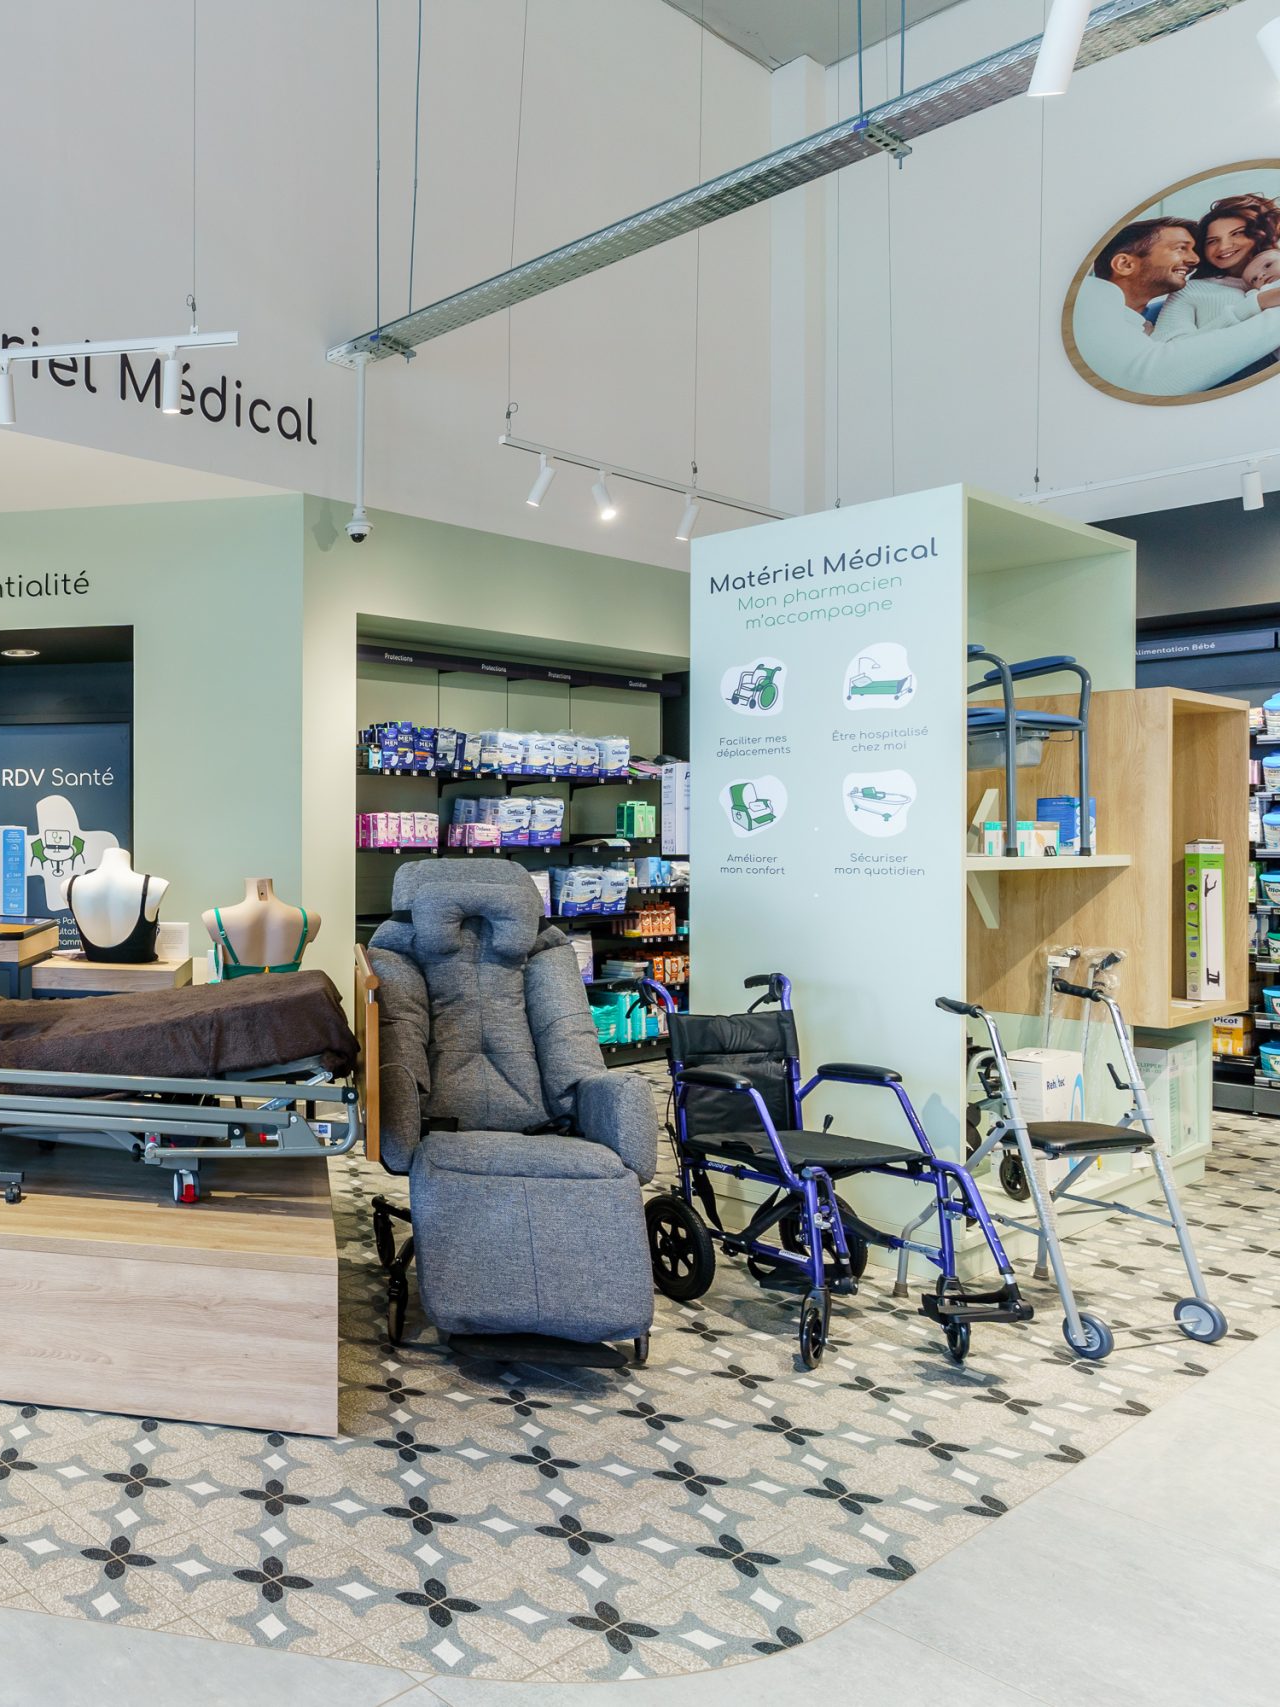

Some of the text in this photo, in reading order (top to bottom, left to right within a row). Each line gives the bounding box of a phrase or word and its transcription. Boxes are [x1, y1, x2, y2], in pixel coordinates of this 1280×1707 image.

[710, 537, 938, 594] Matériel Médical
[738, 576, 902, 611] Mon pharmacien
[745, 600, 893, 629] m'accompagne
[1192, 642, 1215, 651] Bébé
[384, 652, 413, 663] Protections
[481, 663, 507, 673] Protections
[548, 671, 571, 680] Protections
[832, 726, 929, 742] Être hospitalisé
[719, 735, 788, 746] Faciliter mes
[716, 746, 791, 759] déplacements
[851, 741, 906, 753] chez moi
[2, 767, 114, 786] RDV Santé
[726, 853, 778, 863] Améliorer
[850, 852, 908, 863] Sécuriser
[720, 865, 785, 875] mon confort
[834, 865, 925, 877] mon quotidien
[1213, 1016, 1238, 1024] Picot
